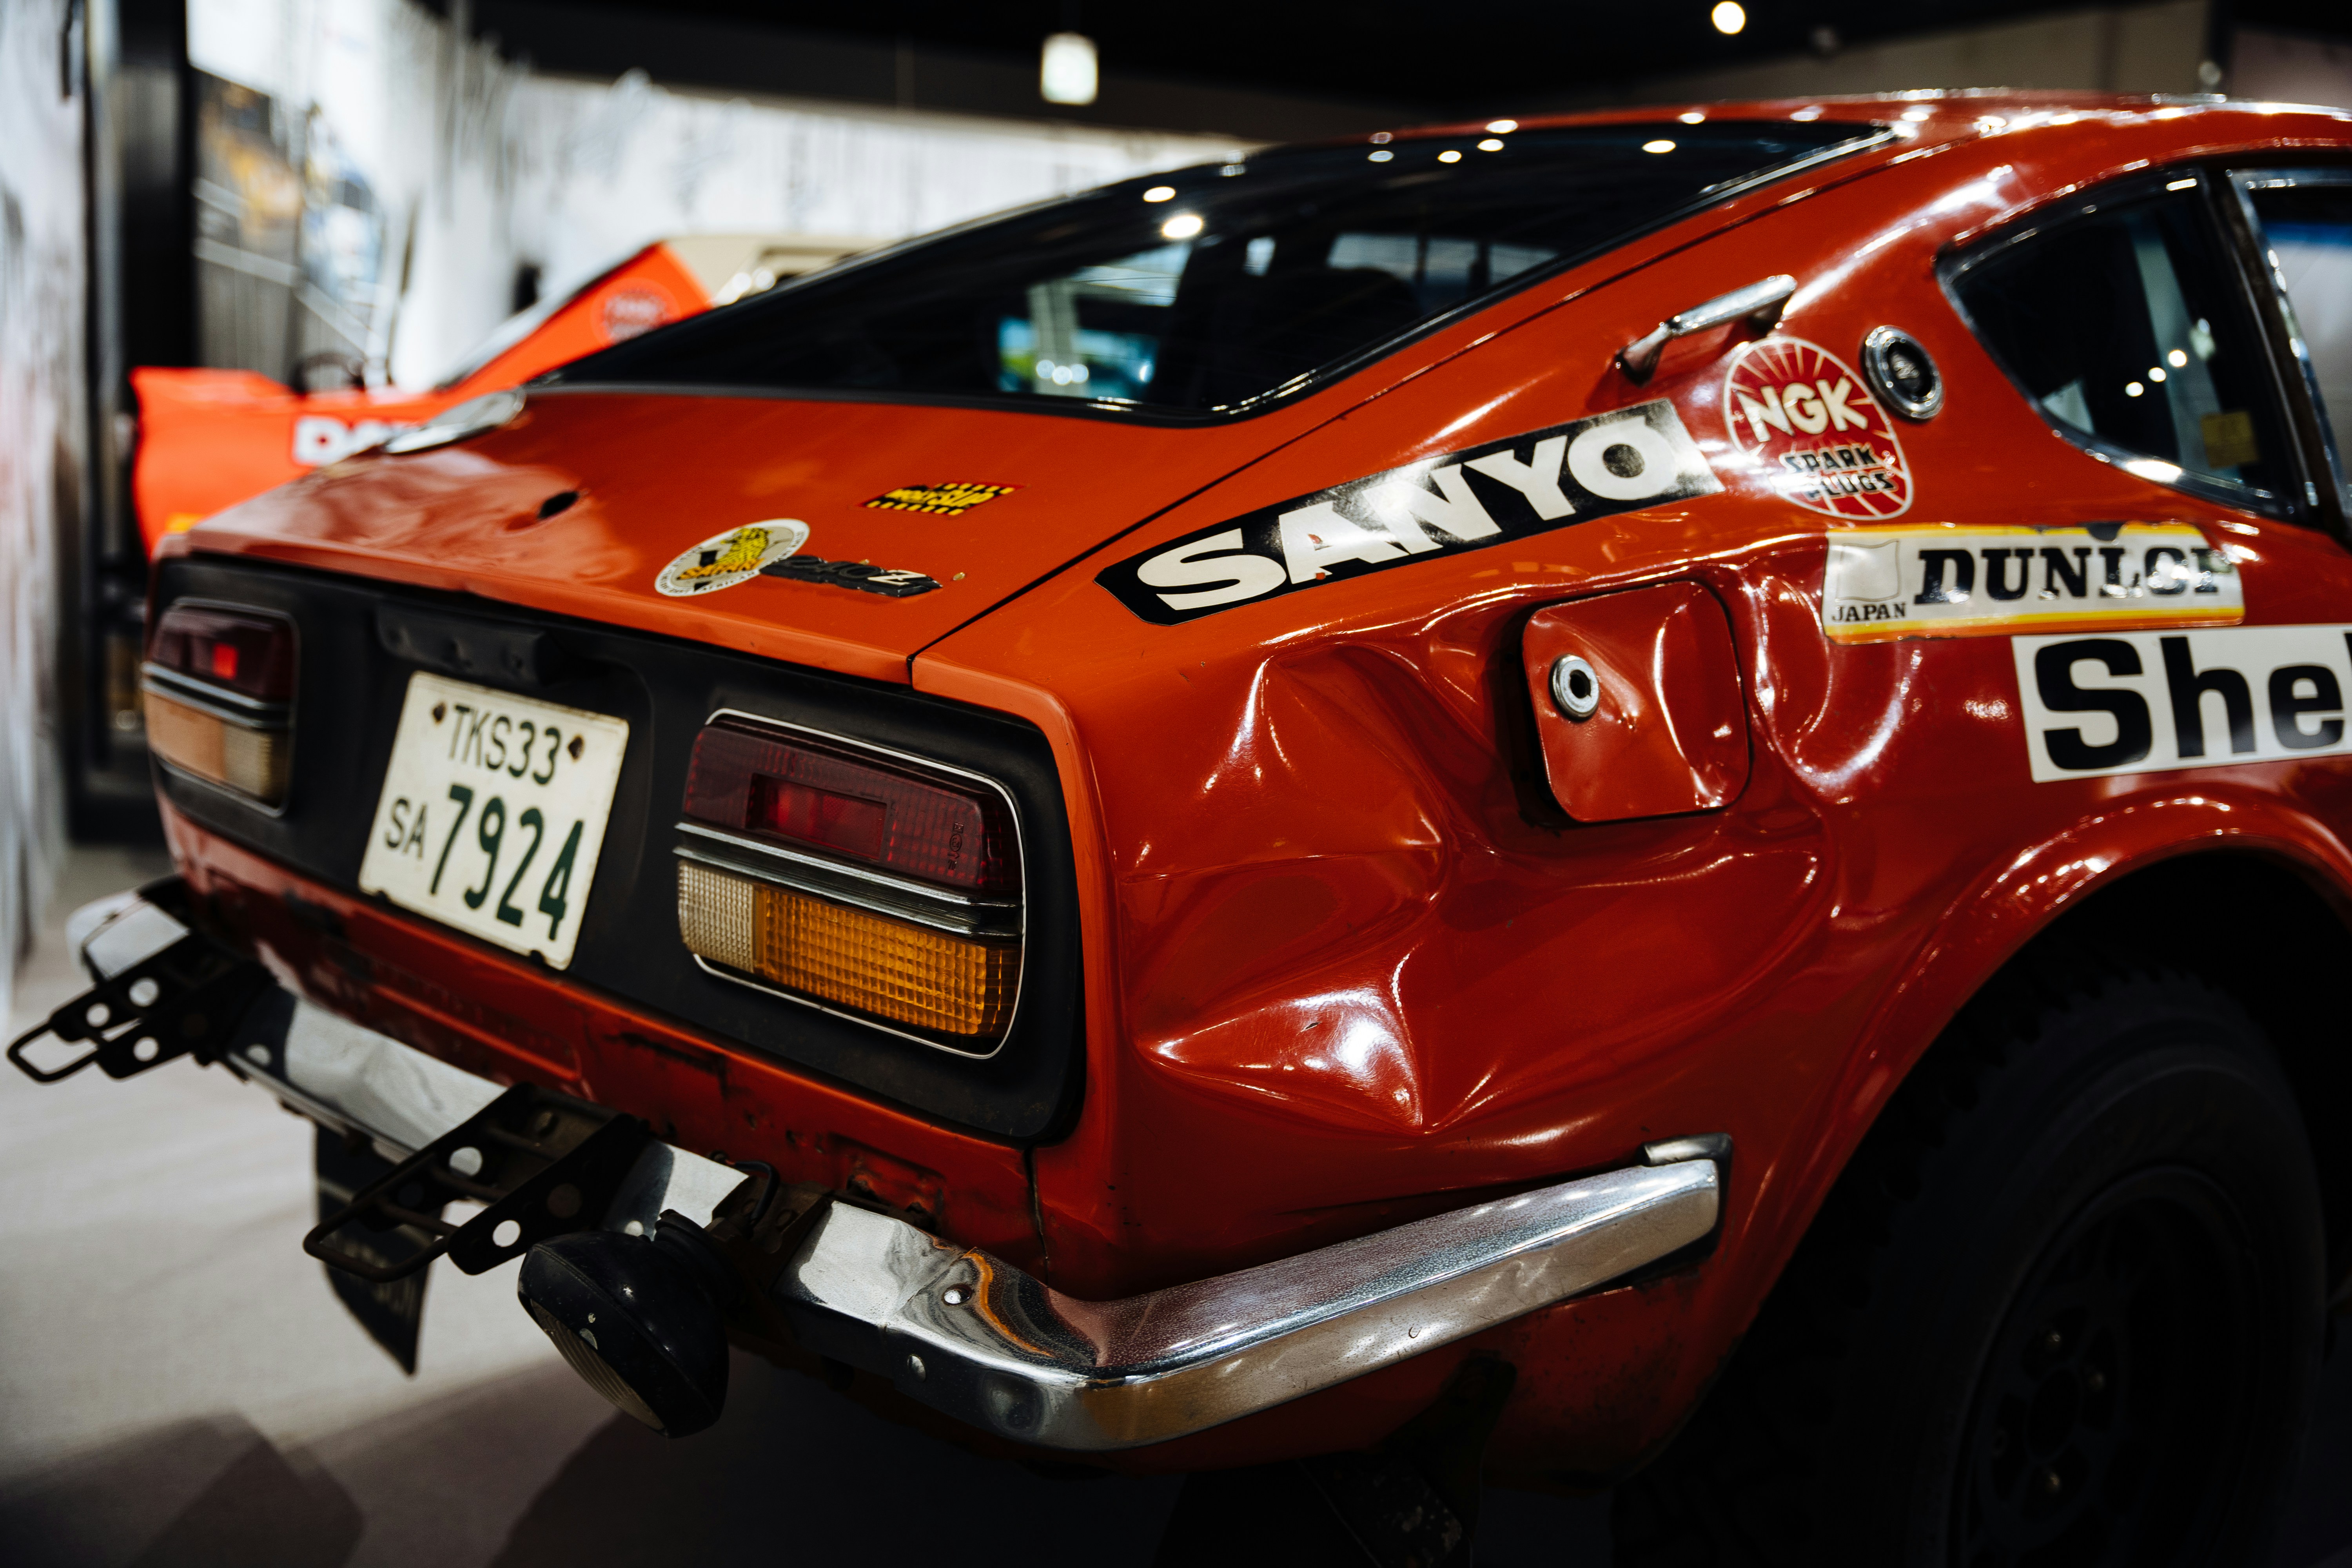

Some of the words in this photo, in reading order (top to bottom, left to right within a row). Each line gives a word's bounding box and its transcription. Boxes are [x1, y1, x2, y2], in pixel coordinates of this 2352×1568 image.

[1735, 376, 1869, 442] NGK
[1780, 444, 1878, 474] SPARK
[1137, 414, 1678, 610] SANYO
[1831, 603, 1907, 622] JAPAN
[2035, 632, 2352, 770] She
[449, 704, 561, 784] TKS33
[384, 798, 428, 860] SA
[430, 784, 584, 941] 7924
